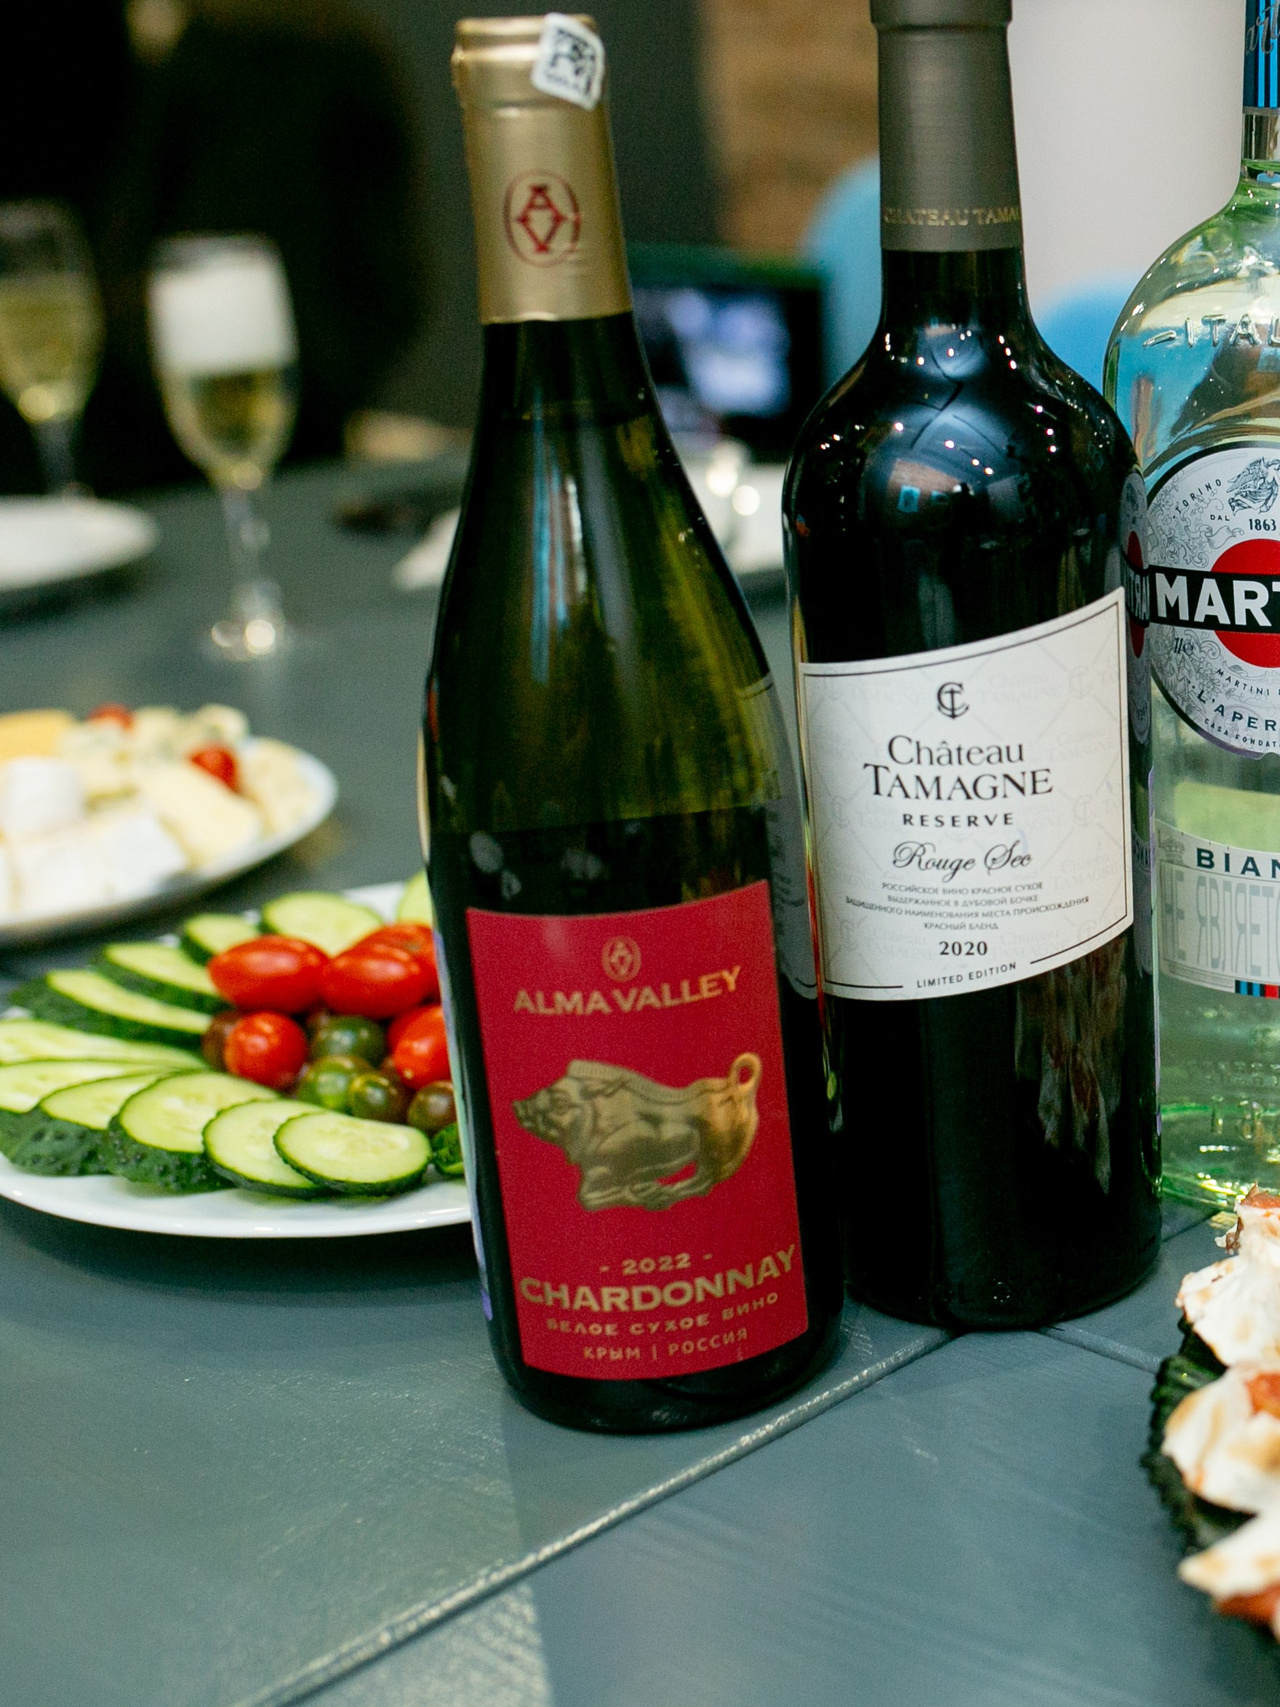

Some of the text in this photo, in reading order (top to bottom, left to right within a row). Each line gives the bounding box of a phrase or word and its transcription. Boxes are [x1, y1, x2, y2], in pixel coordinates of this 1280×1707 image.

[1174, 478, 1222, 515] TORINO
[1210, 514, 1230, 522] DAL
[1248, 518, 1277, 532] 1863
[1216, 668, 1270, 696] MARTINI
[1204, 718, 1229, 737] CASA
[888, 734, 1024, 766] Château
[863, 763, 1053, 800] TAMAGNE
[903, 812, 1014, 827] RESERVE
[892, 841, 976, 883] Rouge
[984, 839, 1034, 876] Sec
[882, 881, 1043, 895] РОССИЙСКОЕ ВИНО КРАСНОЕ СУХОЕ
[887, 895, 951, 907] ВЫДЕРЖАННОЕ
[961, 896, 1008, 908] ДУБОВОЙ
[1009, 895, 1038, 905] БОЧКЕ
[905, 909, 979, 919] НАИМЕНОВАНИЯ
[982, 909, 1012, 918] МЕСТА
[1013, 895, 1090, 916] ПРОИСХОЖДЕНИЯ
[923, 921, 999, 931] КРАСНЫЙ БЛЕНД
[939, 941, 988, 956] 2020
[916, 961, 1017, 988] LIMITED EDITION
[513, 964, 741, 1016] ALMA VALLEY
[622, 1252, 691, 1276] 2022
[519, 1243, 796, 1313] CHARDONNAY
[547, 1291, 779, 1336] БЕЛОЕ СУХОЕ ВИНО
[584, 1326, 748, 1362] КРЫМ РОССИЯ
